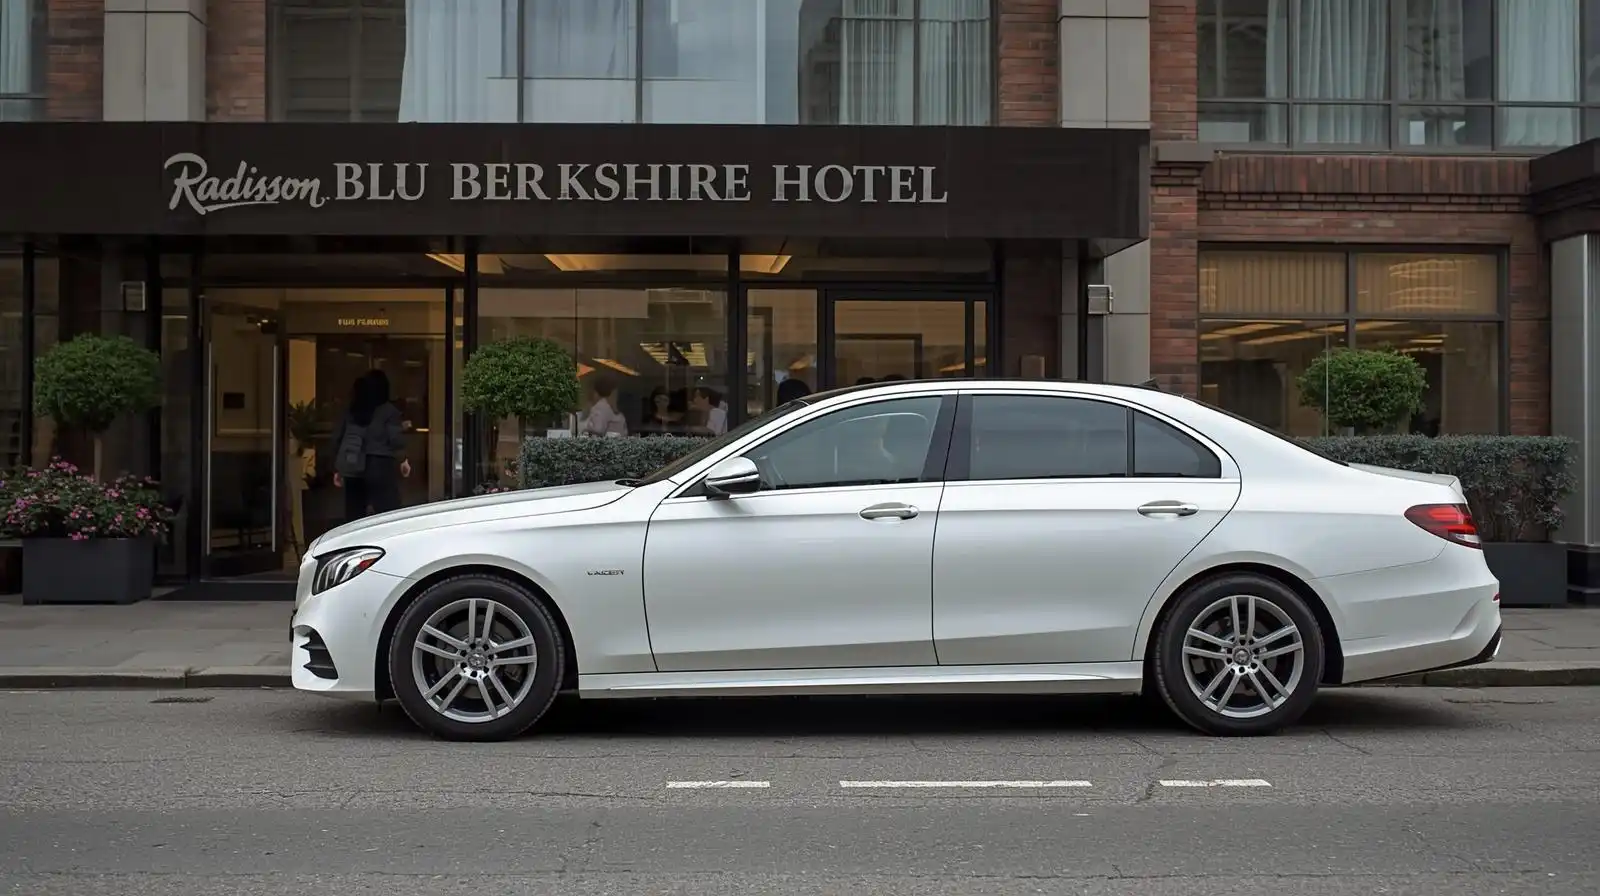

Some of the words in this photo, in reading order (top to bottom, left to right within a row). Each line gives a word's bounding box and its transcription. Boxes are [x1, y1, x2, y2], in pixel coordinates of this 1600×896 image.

[164, 152, 327, 215] Radisson
[334, 163, 428, 201] BLU
[450, 162, 751, 203] BERKSHIRE
[773, 164, 949, 204] HOTEL
